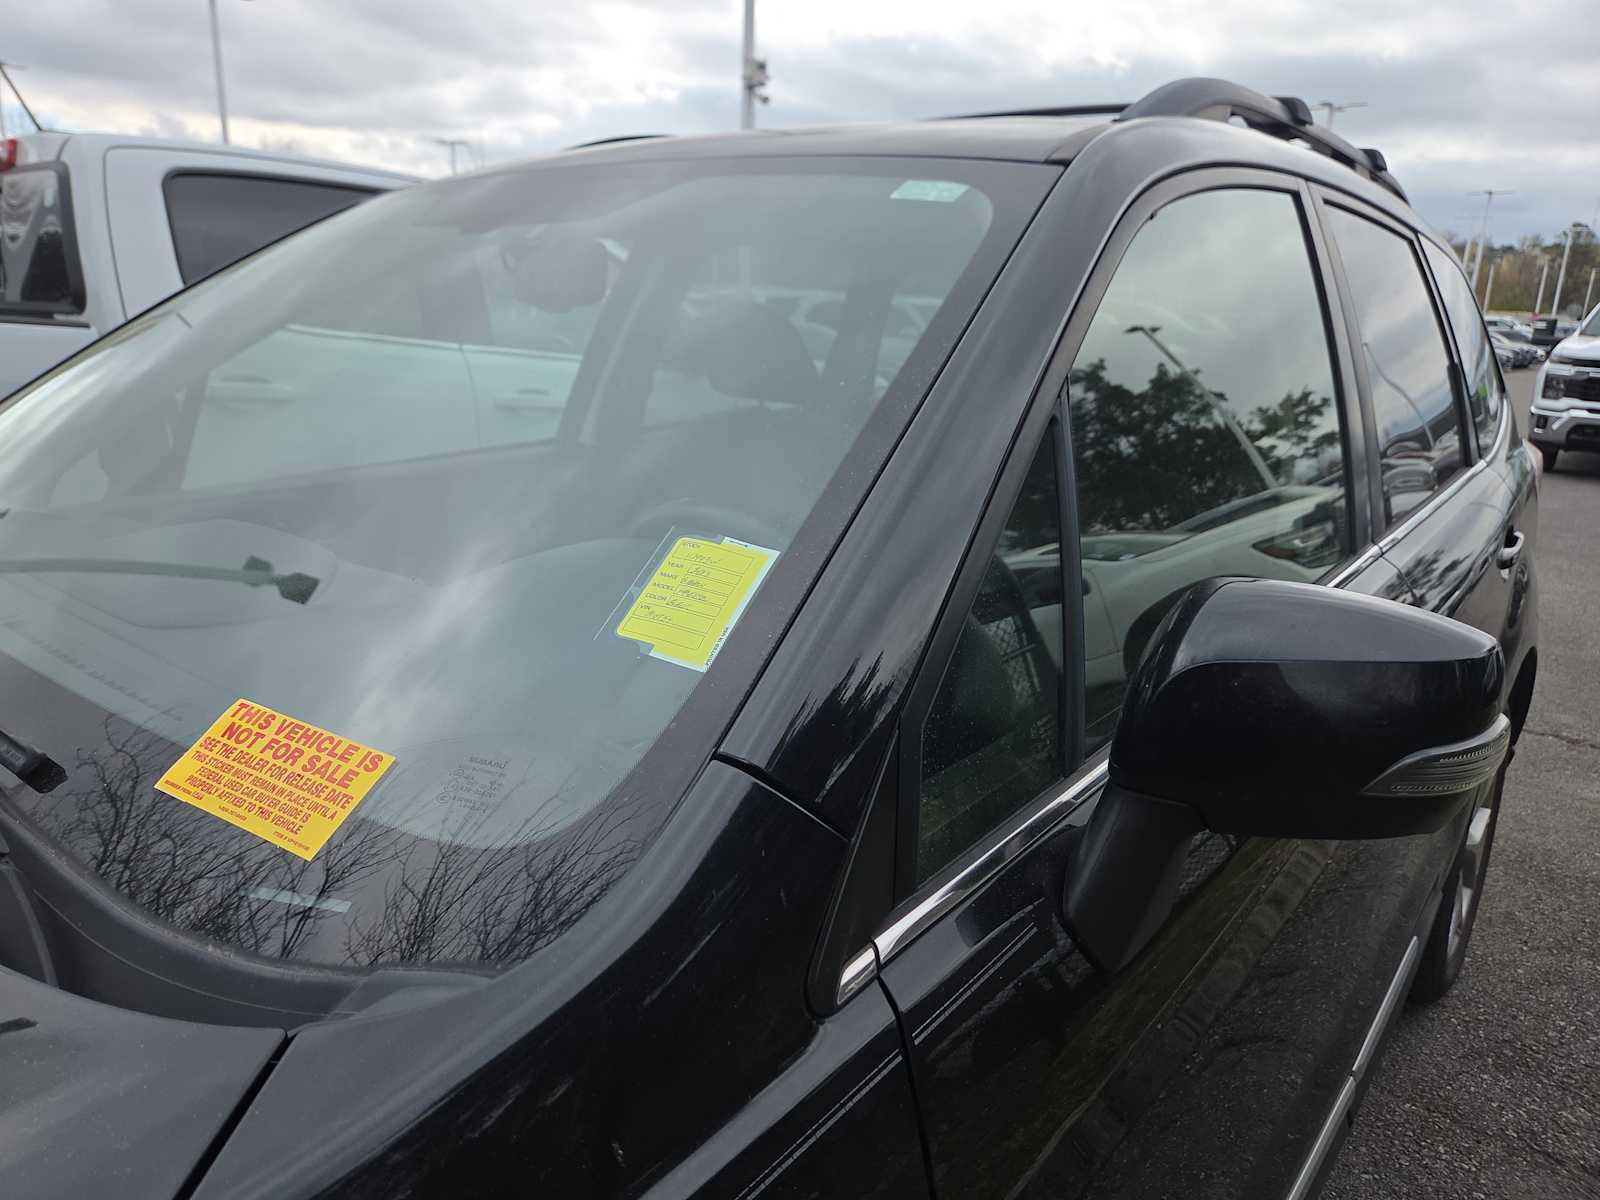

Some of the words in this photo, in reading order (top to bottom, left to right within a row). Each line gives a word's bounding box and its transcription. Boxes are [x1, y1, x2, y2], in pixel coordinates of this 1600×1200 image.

[220, 721, 267, 749] NOT
[259, 737, 305, 767] FOR
[301, 754, 361, 789] SALE
[230, 702, 277, 731] THIS
[274, 718, 361, 764] VEHICLE
[355, 750, 384, 773] IS
[184, 774, 218, 795] PROPERLY
[218, 789, 246, 808] AFFIXED
[244, 801, 257, 813] TO
[255, 806, 273, 821] THIS
[271, 813, 304, 836] VEHICLE
[191, 750, 209, 763] THIS
[206, 756, 235, 775] STICKER
[231, 767, 254, 783] MUST
[249, 775, 278, 794] REMAIN
[284, 790, 310, 808] PLACE
[307, 800, 331, 818] UNTIL
[195, 765, 225, 785] FEDERAL
[223, 779, 243, 793] USED
[240, 786, 258, 800] CAR
[255, 792, 280, 809] BUYER
[278, 802, 303, 820] GUIDE
[300, 812, 311, 824] IS
[199, 736, 222, 753] SEE
[215, 742, 238, 760] THE
[231, 750, 270, 773] DEALER
[264, 763, 289, 782] FOR
[283, 771, 329, 799] RELEASE
[324, 788, 354, 810] DATE
